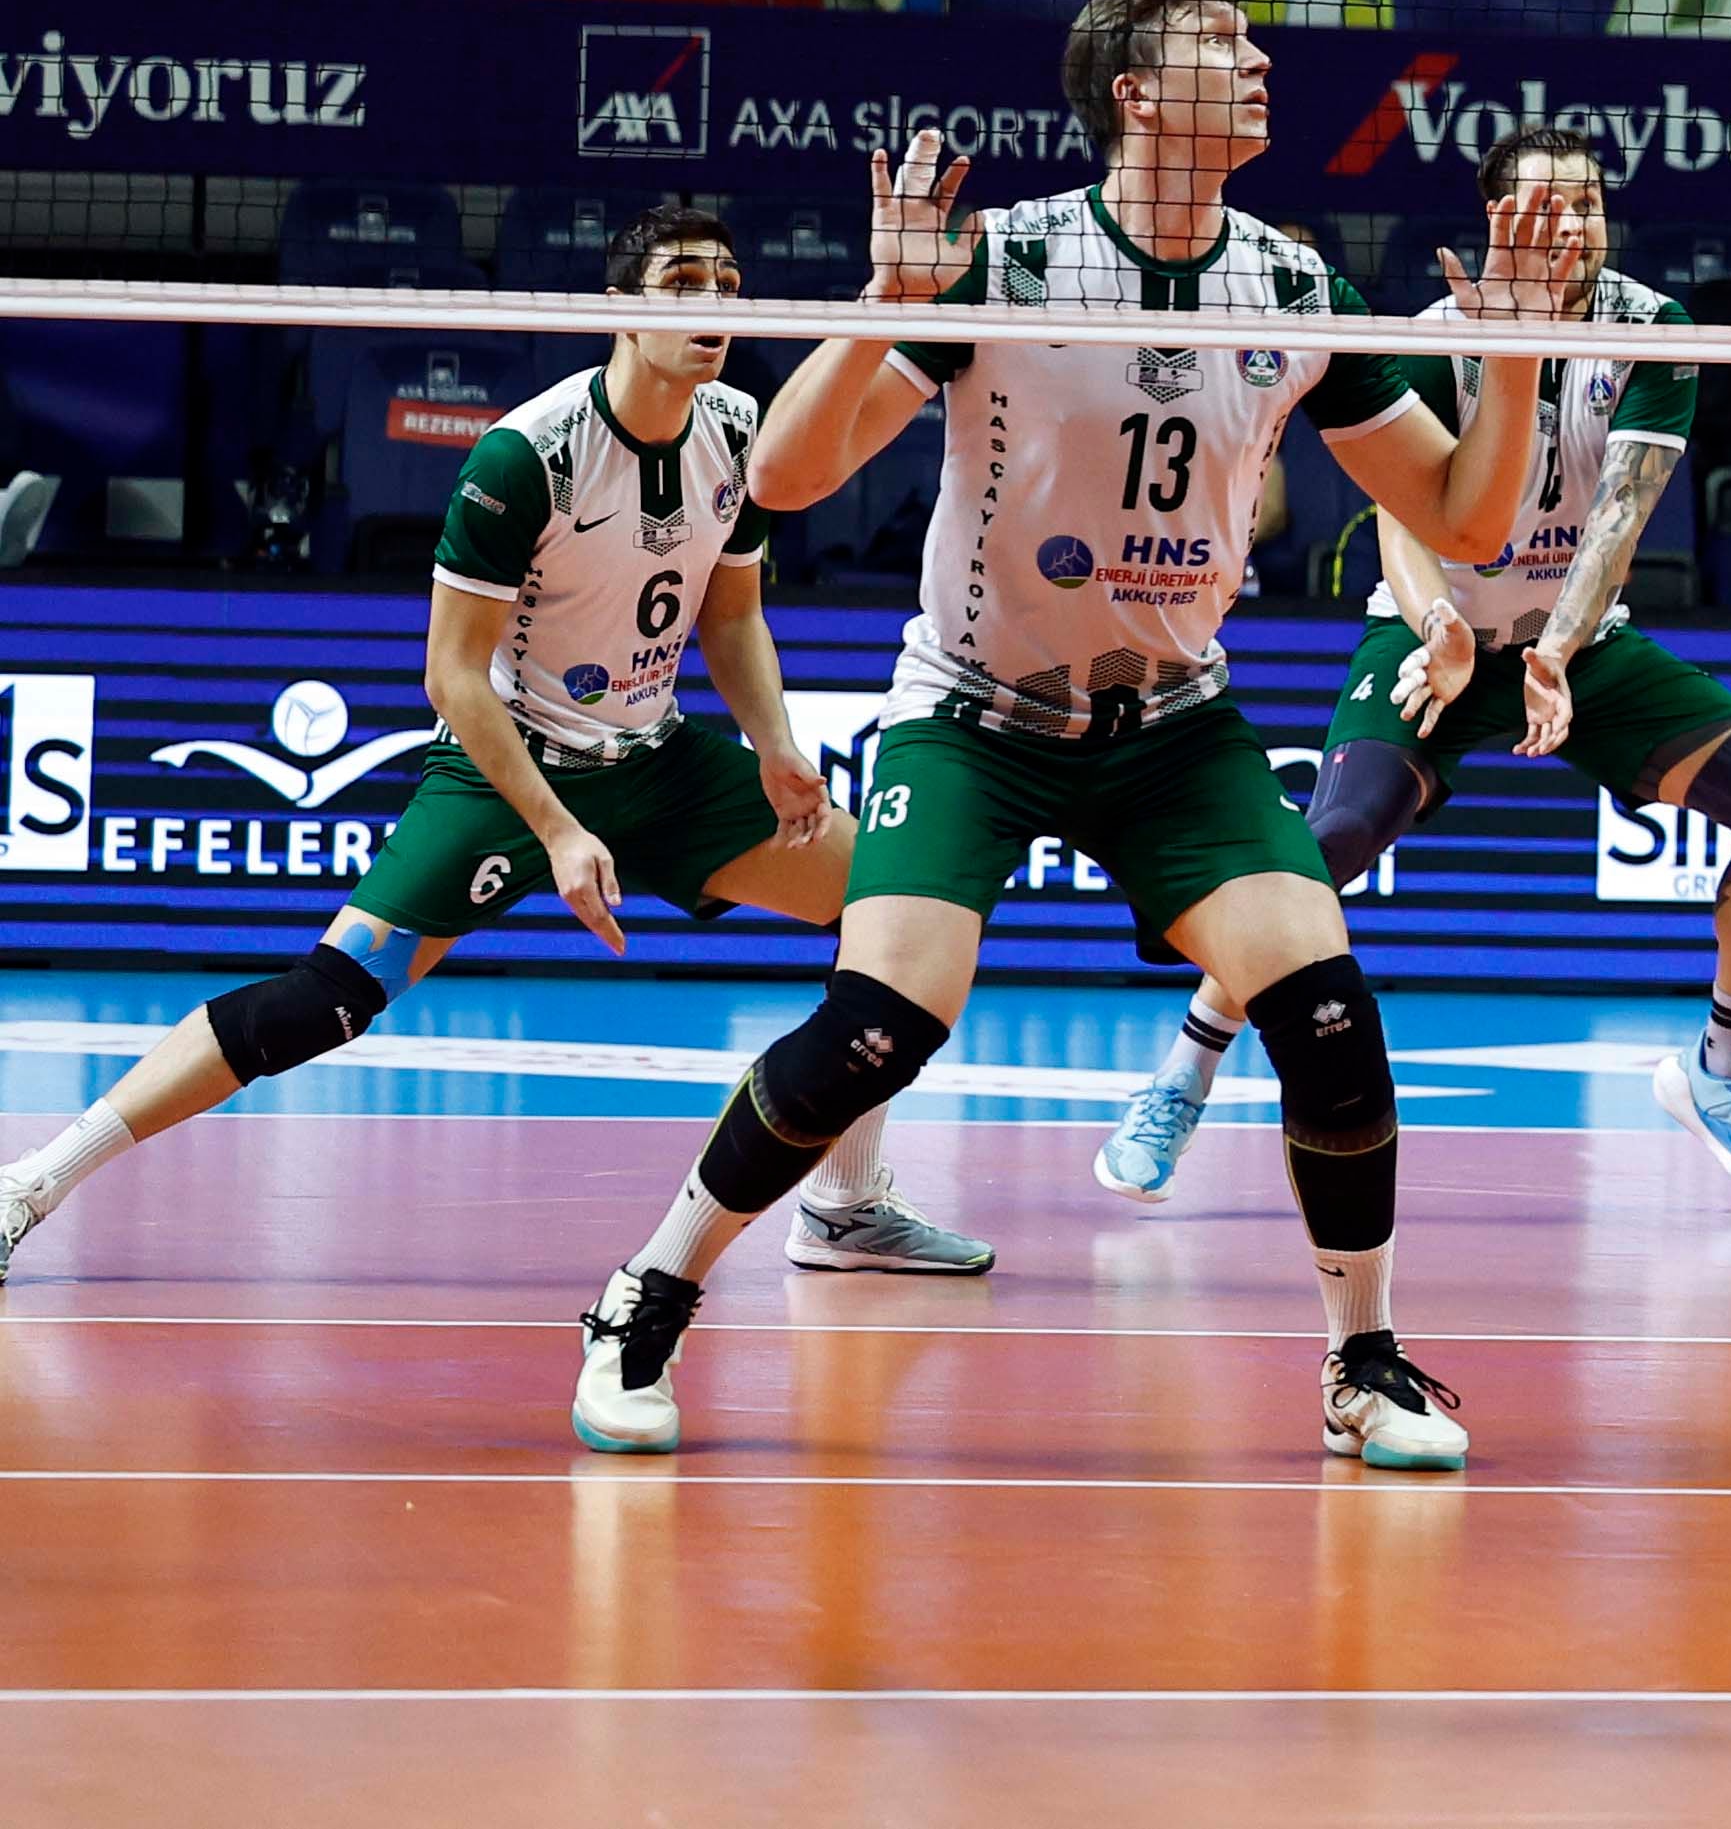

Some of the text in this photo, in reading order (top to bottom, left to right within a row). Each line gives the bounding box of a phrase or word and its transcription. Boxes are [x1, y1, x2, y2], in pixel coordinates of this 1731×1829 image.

[582, 90, 684, 145] AXA
[728, 96, 838, 149] AXA
[1119, 412, 1198, 513] 13
[1122, 534, 1211, 568] HNS
[1529, 525, 1585, 550] HN
[1095, 566, 1147, 587] ENERJİ
[1169, 589, 1198, 606] RES
[637, 570, 683, 639] 6
[1349, 673, 1376, 703] 4
[864, 785, 910, 832] 13
[103, 817, 371, 876] EFELER
[469, 854, 511, 905] 6
